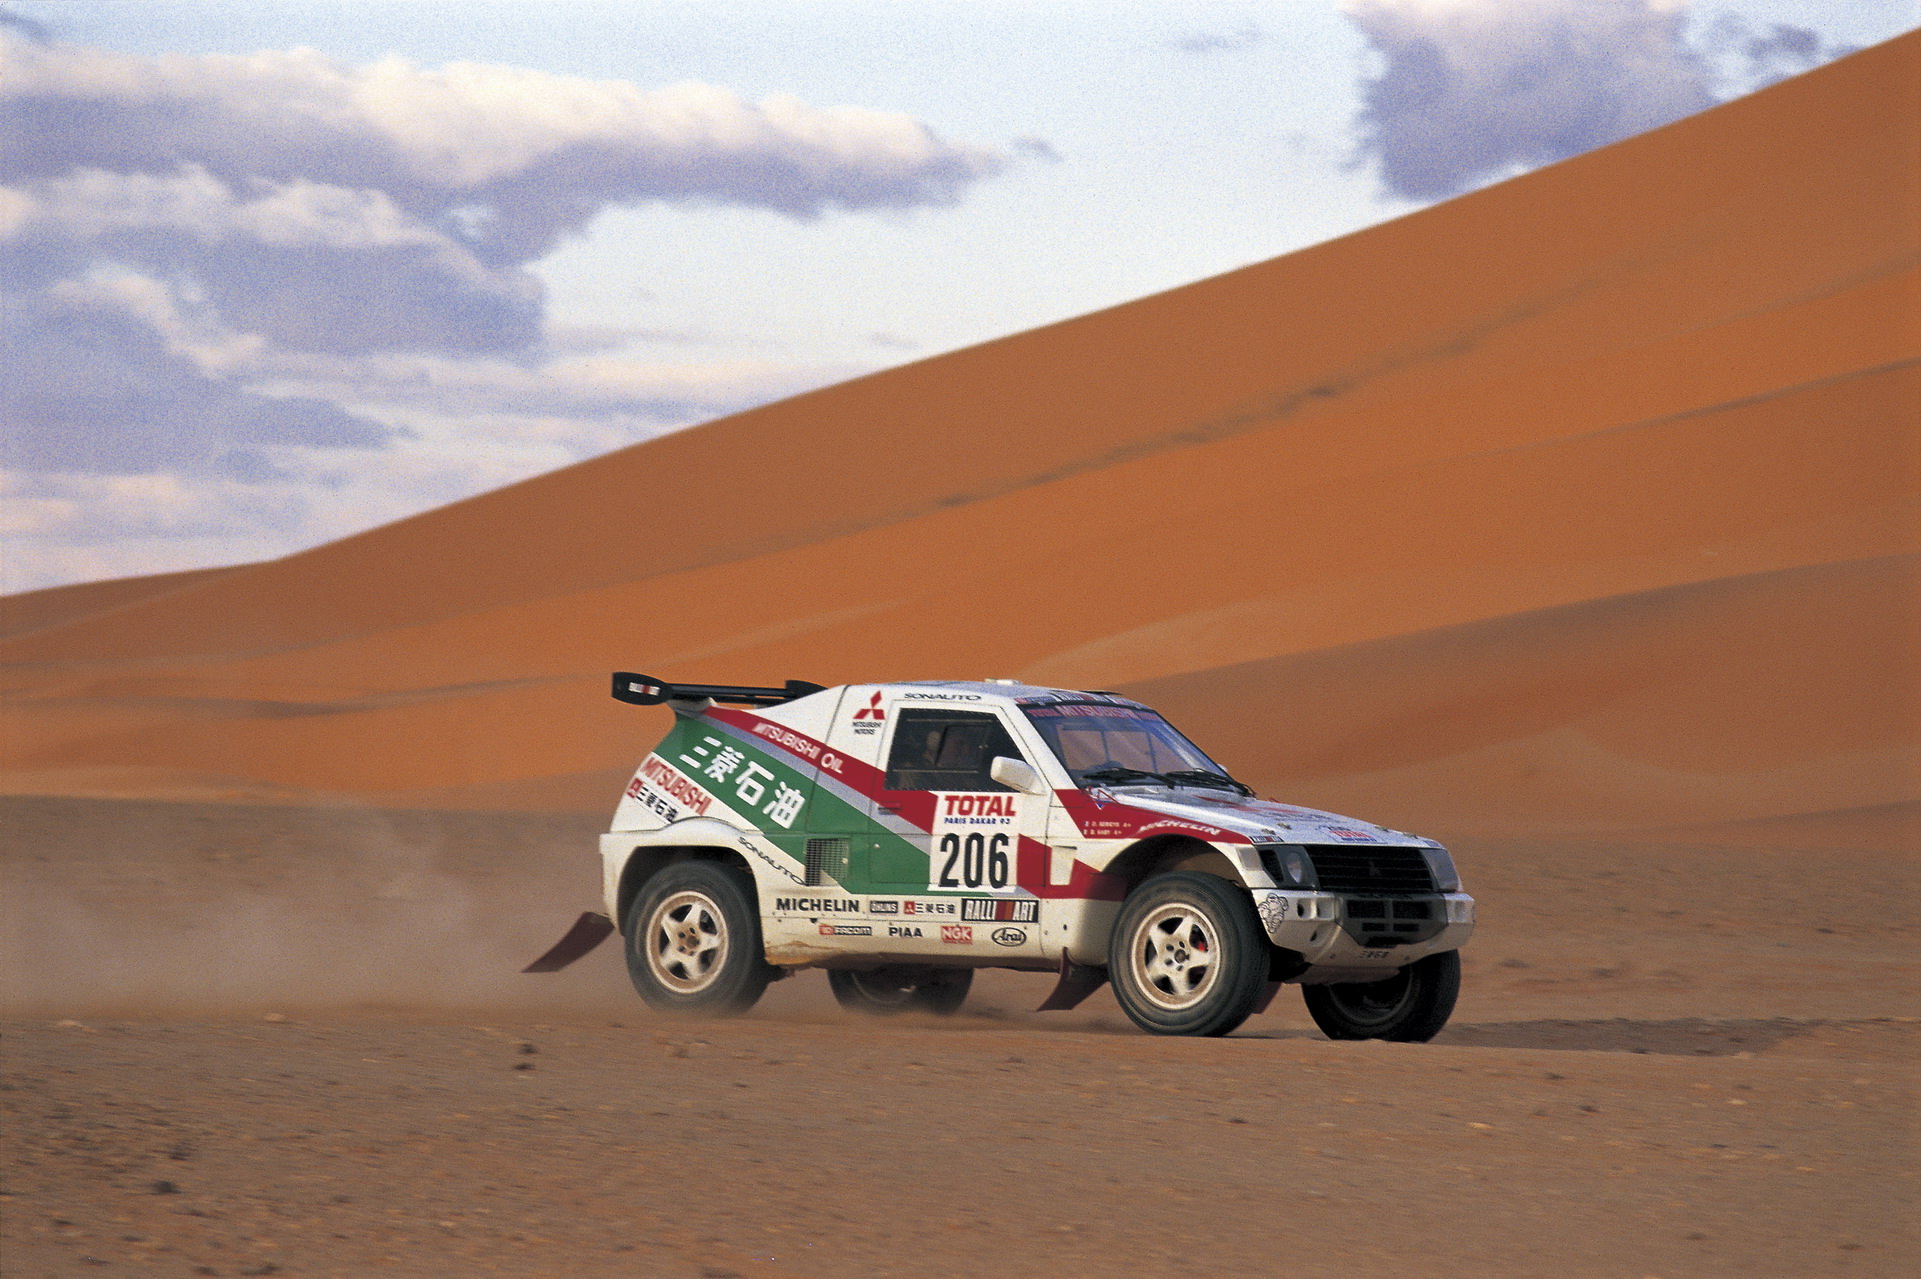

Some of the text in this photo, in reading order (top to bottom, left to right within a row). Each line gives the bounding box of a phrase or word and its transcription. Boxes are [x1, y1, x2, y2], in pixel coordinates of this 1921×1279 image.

[903, 692, 982, 701] SONAUTO
[752, 722, 843, 774] MITSUBISHI OIL
[640, 757, 712, 815] MITSUBISHI
[679, 736, 805, 829] 三菱石油
[944, 795, 1017, 817] TOTAL
[1137, 819, 1221, 836] MICHELIN
[738, 836, 806, 886] SONAUTO
[938, 832, 1009, 889] 206
[776, 898, 859, 912] MICHELIN
[916, 903, 956, 914] 三菱石油
[964, 900, 1037, 921] RALLI ART
[889, 927, 923, 937] PIAA
[942, 927, 972, 940] NGK
[994, 928, 1023, 942] Arai
